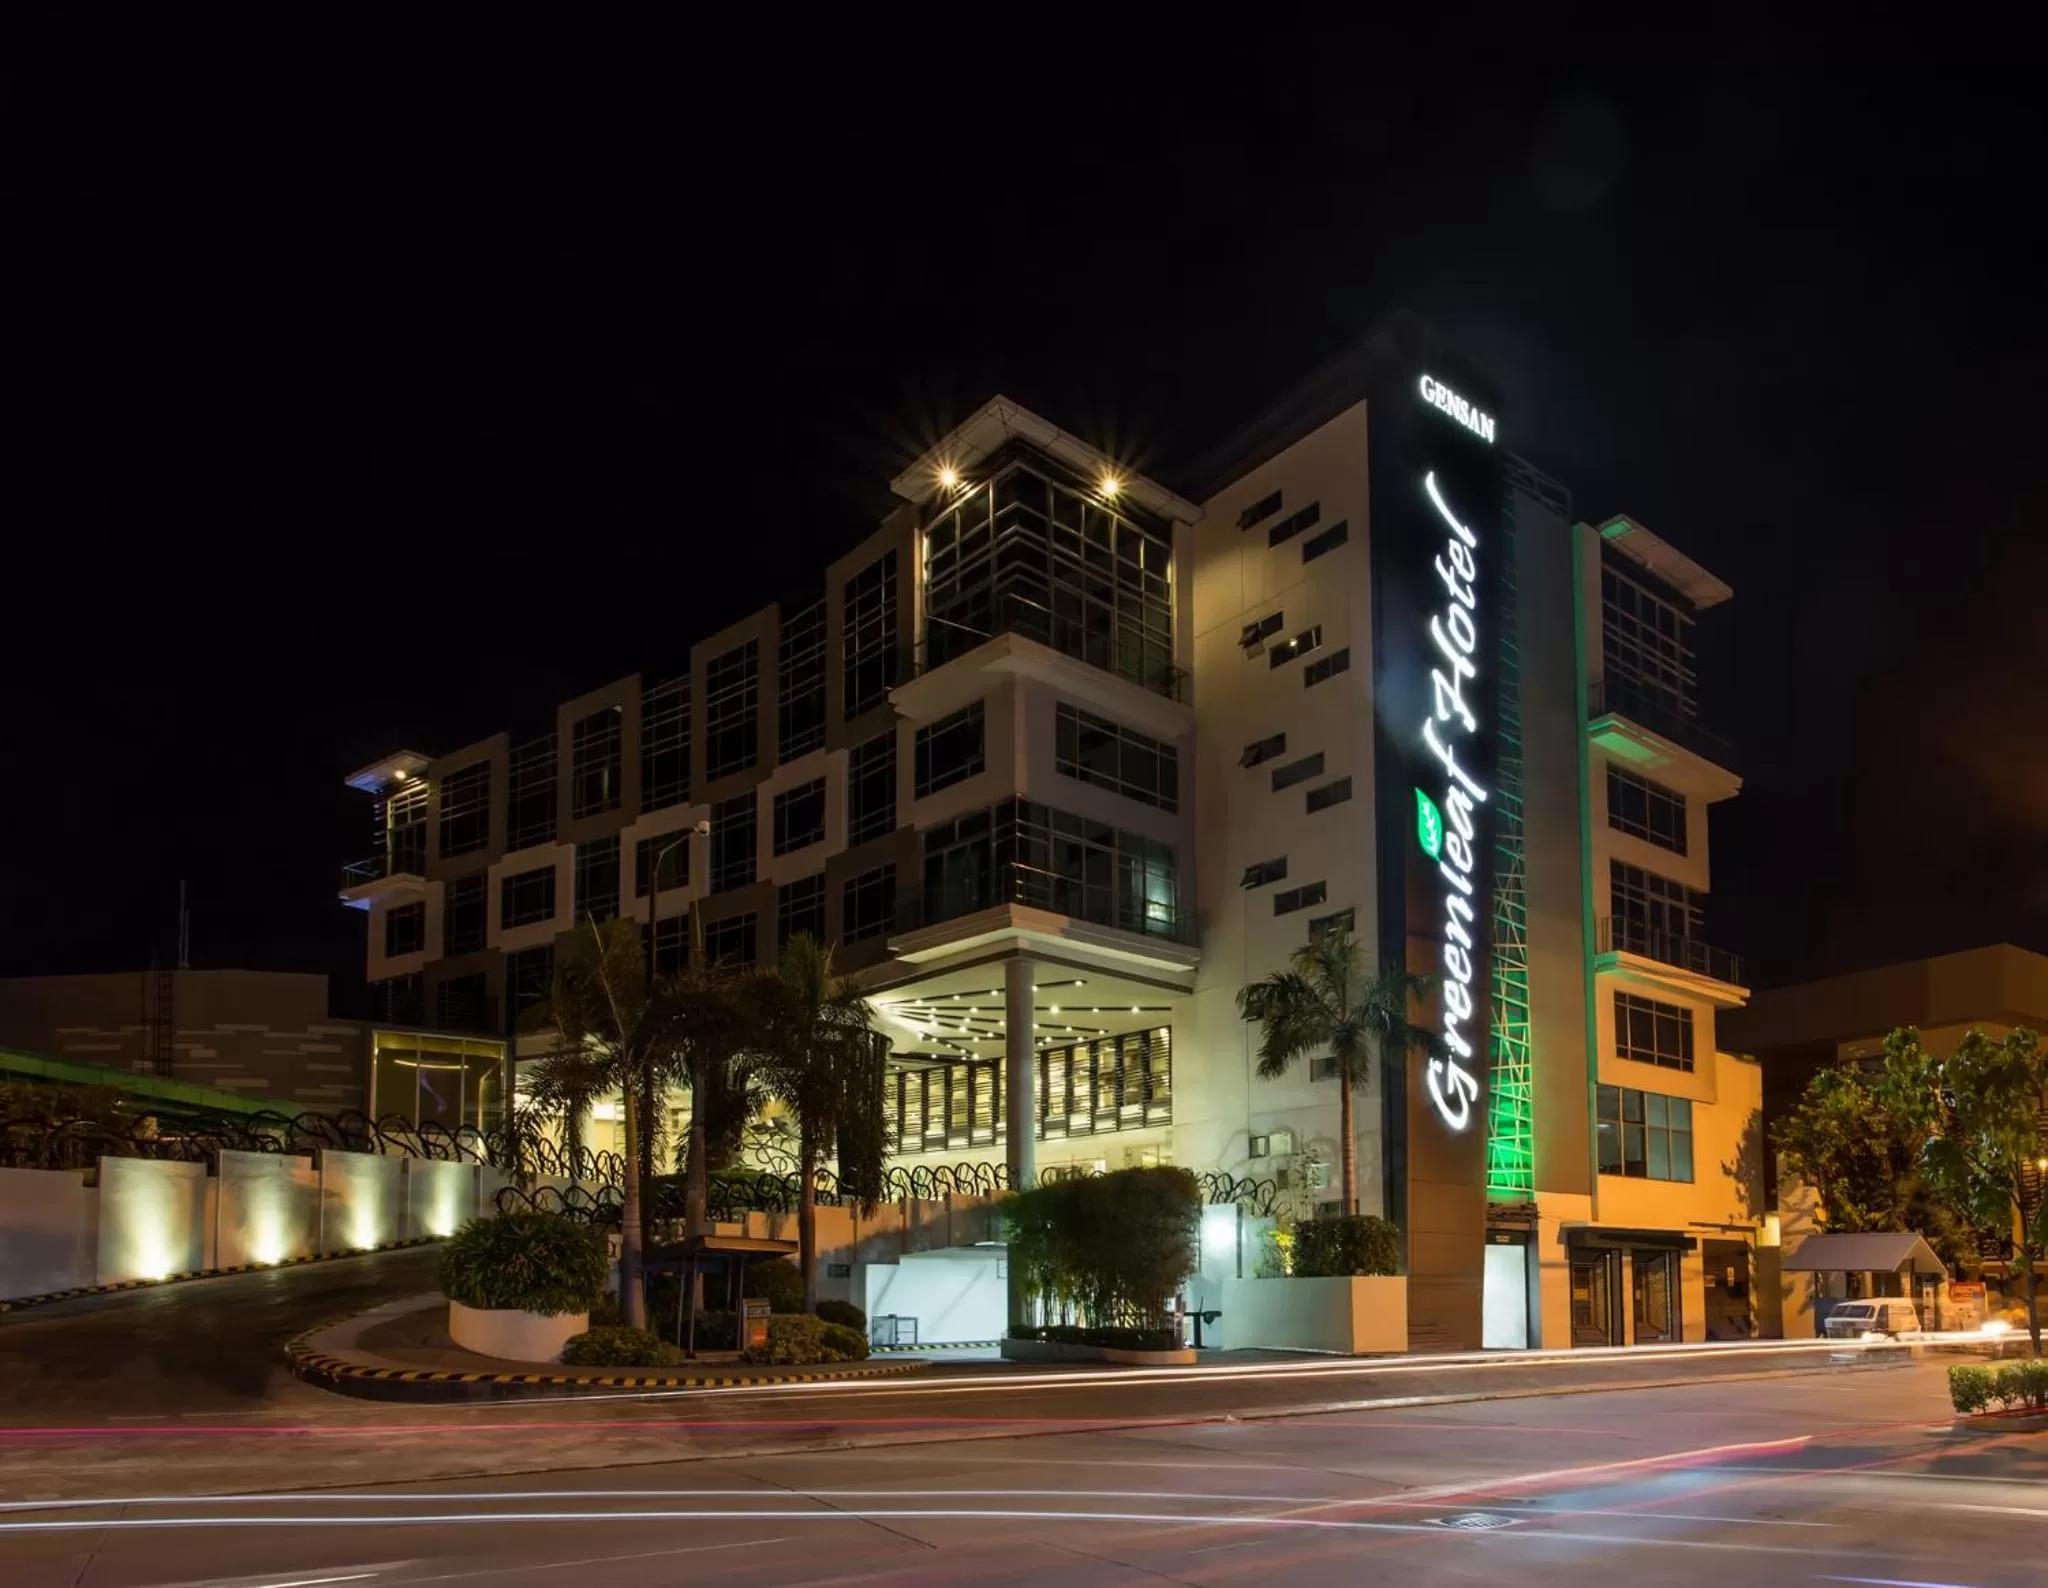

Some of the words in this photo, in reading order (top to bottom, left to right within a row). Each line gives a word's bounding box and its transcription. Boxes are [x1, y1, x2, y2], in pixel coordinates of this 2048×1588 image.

[1420, 374, 1495, 443] GENSAN
[1426, 471, 1476, 732] Hotel
[1424, 716, 1488, 1131] Greenleaf
